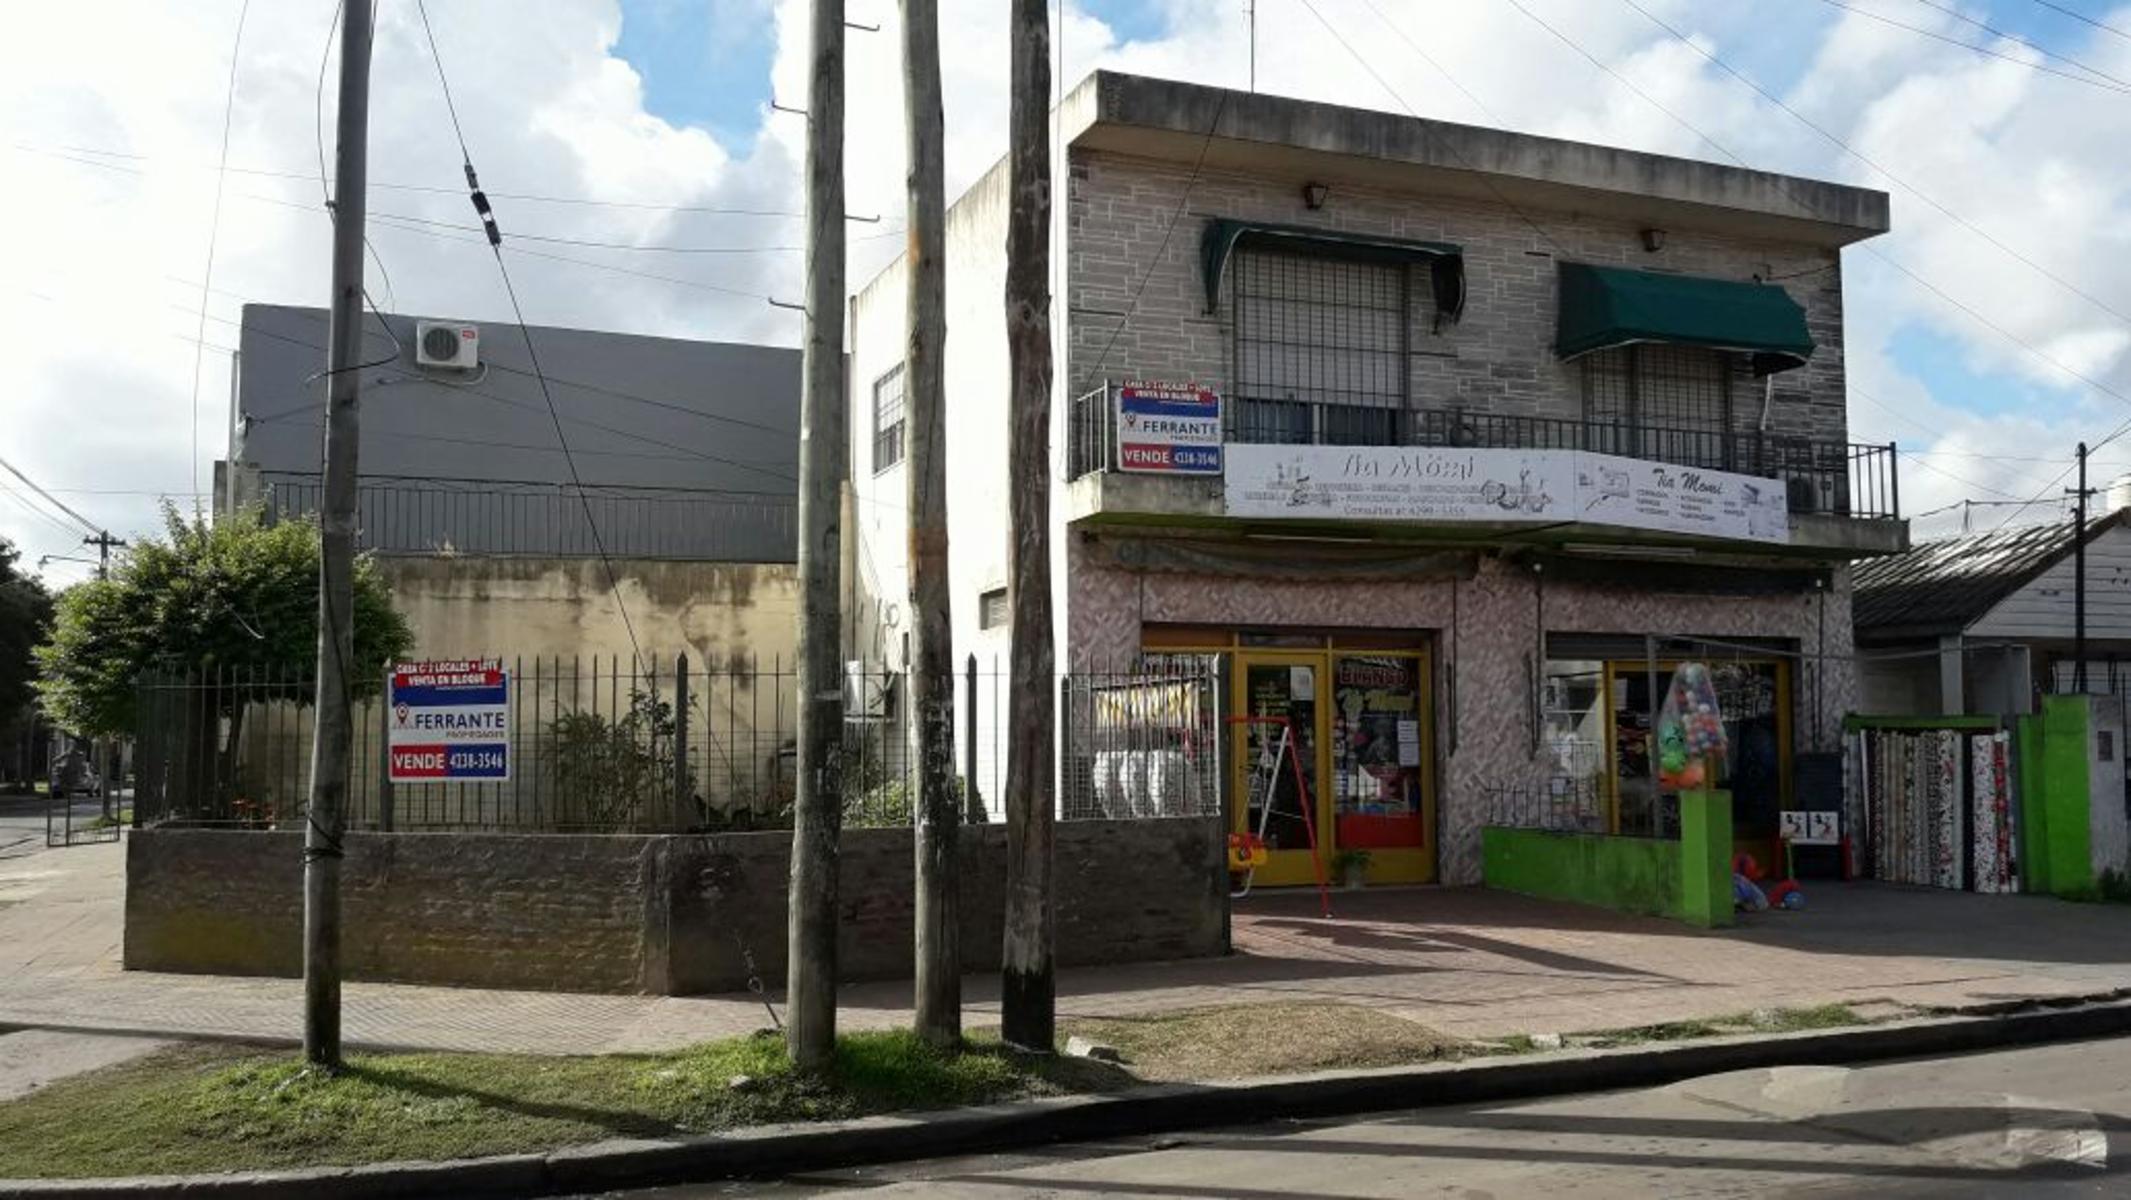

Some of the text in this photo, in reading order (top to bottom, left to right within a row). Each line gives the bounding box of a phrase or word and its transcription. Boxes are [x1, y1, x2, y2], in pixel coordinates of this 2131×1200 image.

[1143, 420, 1218, 435] FERRANTE
[1124, 450, 1170, 464] VENDE
[396, 664, 417, 674] CASA
[435, 662, 469, 673] LOCALES
[408, 673, 486, 686] VENTA EN BLOQUE
[415, 712, 505, 730] FERRANTE
[393, 752, 503, 769] VENDE 4238-3546
